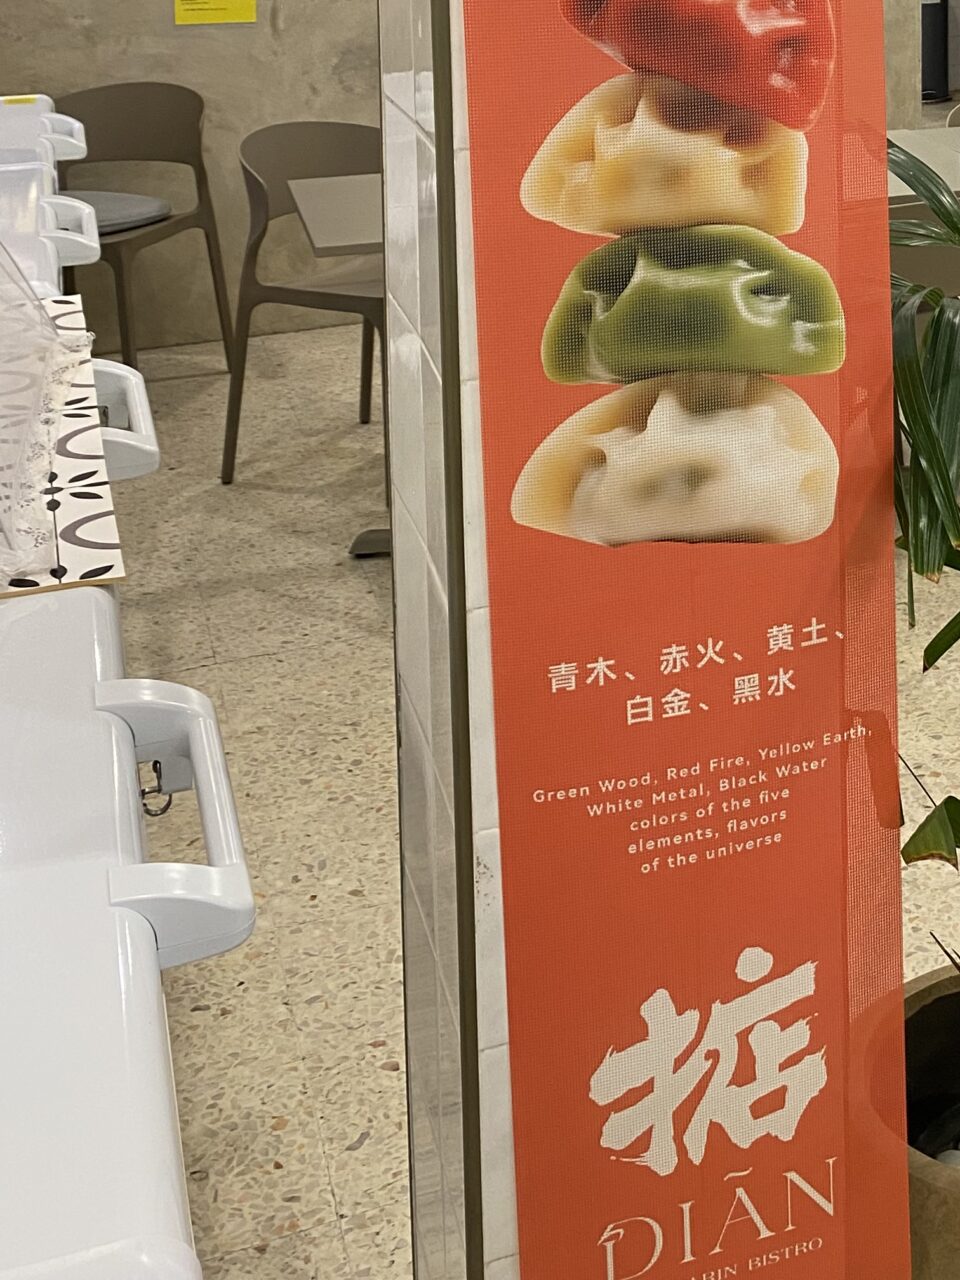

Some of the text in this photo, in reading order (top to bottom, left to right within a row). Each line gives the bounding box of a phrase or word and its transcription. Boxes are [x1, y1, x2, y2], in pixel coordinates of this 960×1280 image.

[532, 724, 873, 803] Green Wood, Red Fire, Yellow Earth,
[587, 756, 828, 817] White Metal, Black Water
[627, 809, 788, 855] elements, flavors
[629, 786, 791, 832] colors of the five
[640, 831, 783, 874] of the universe
[748, 1237, 824, 1271] BISTRO
